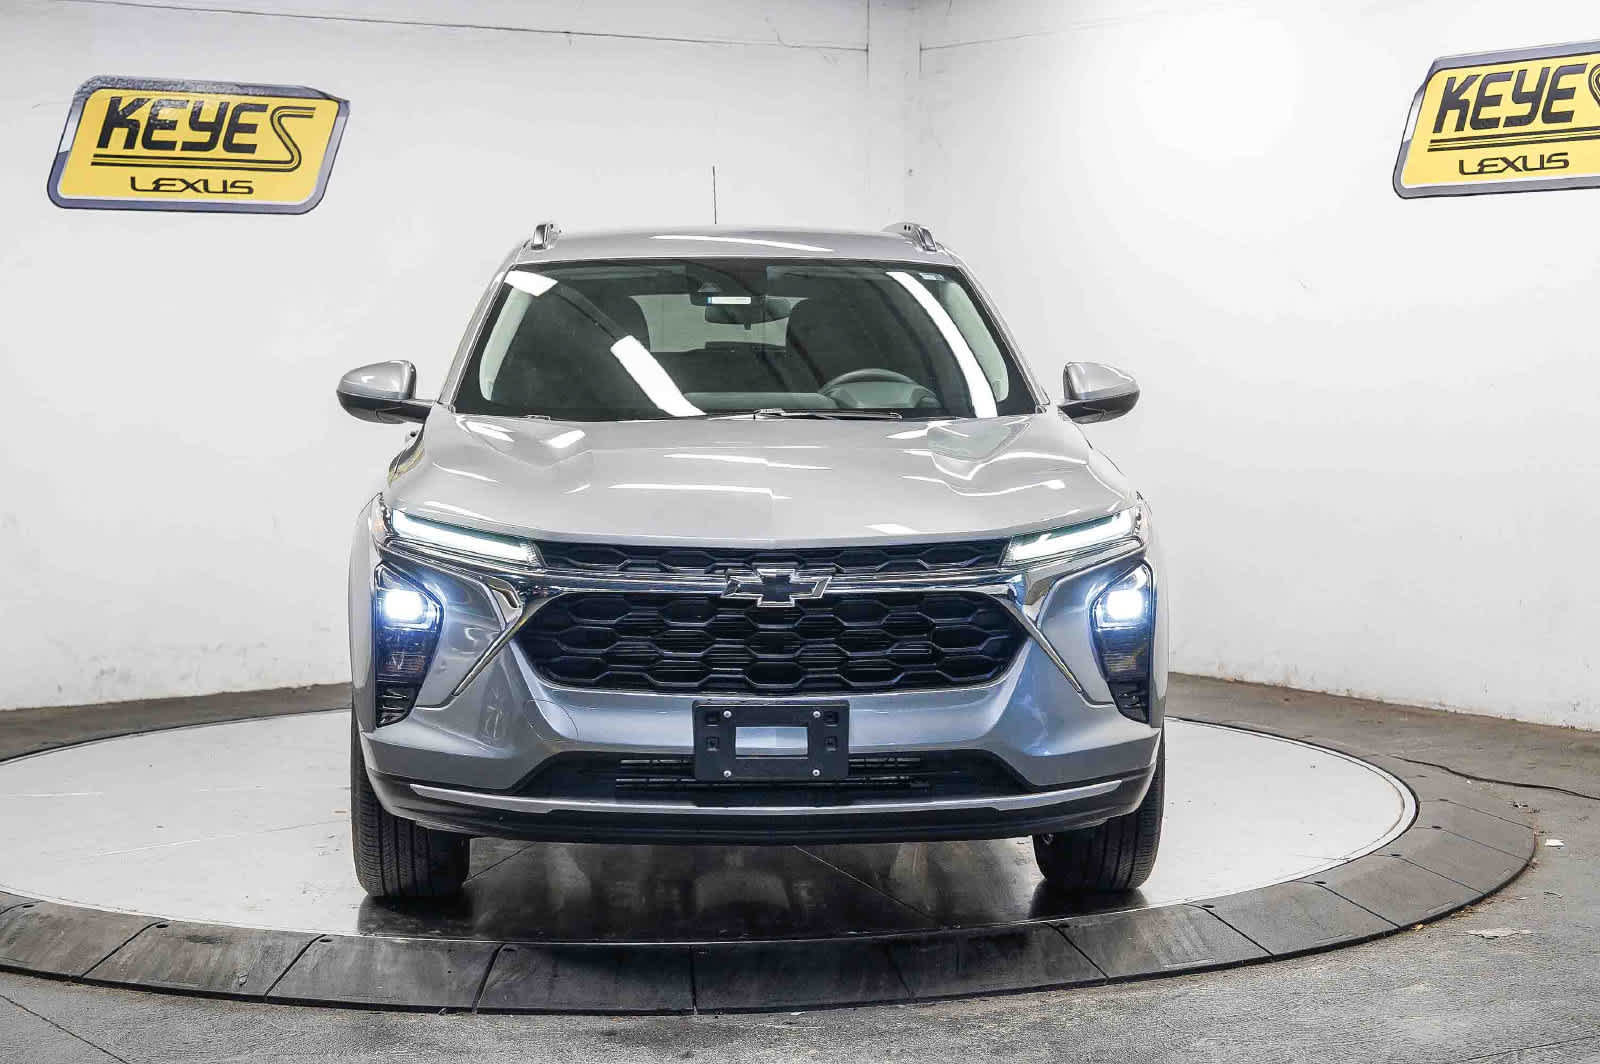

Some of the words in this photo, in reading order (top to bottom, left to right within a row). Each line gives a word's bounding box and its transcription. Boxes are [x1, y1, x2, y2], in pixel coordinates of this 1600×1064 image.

[95, 96, 316, 171] KEYES
[1458, 152, 1570, 175] LEXUS
[130, 176, 254, 194] LEXUS
